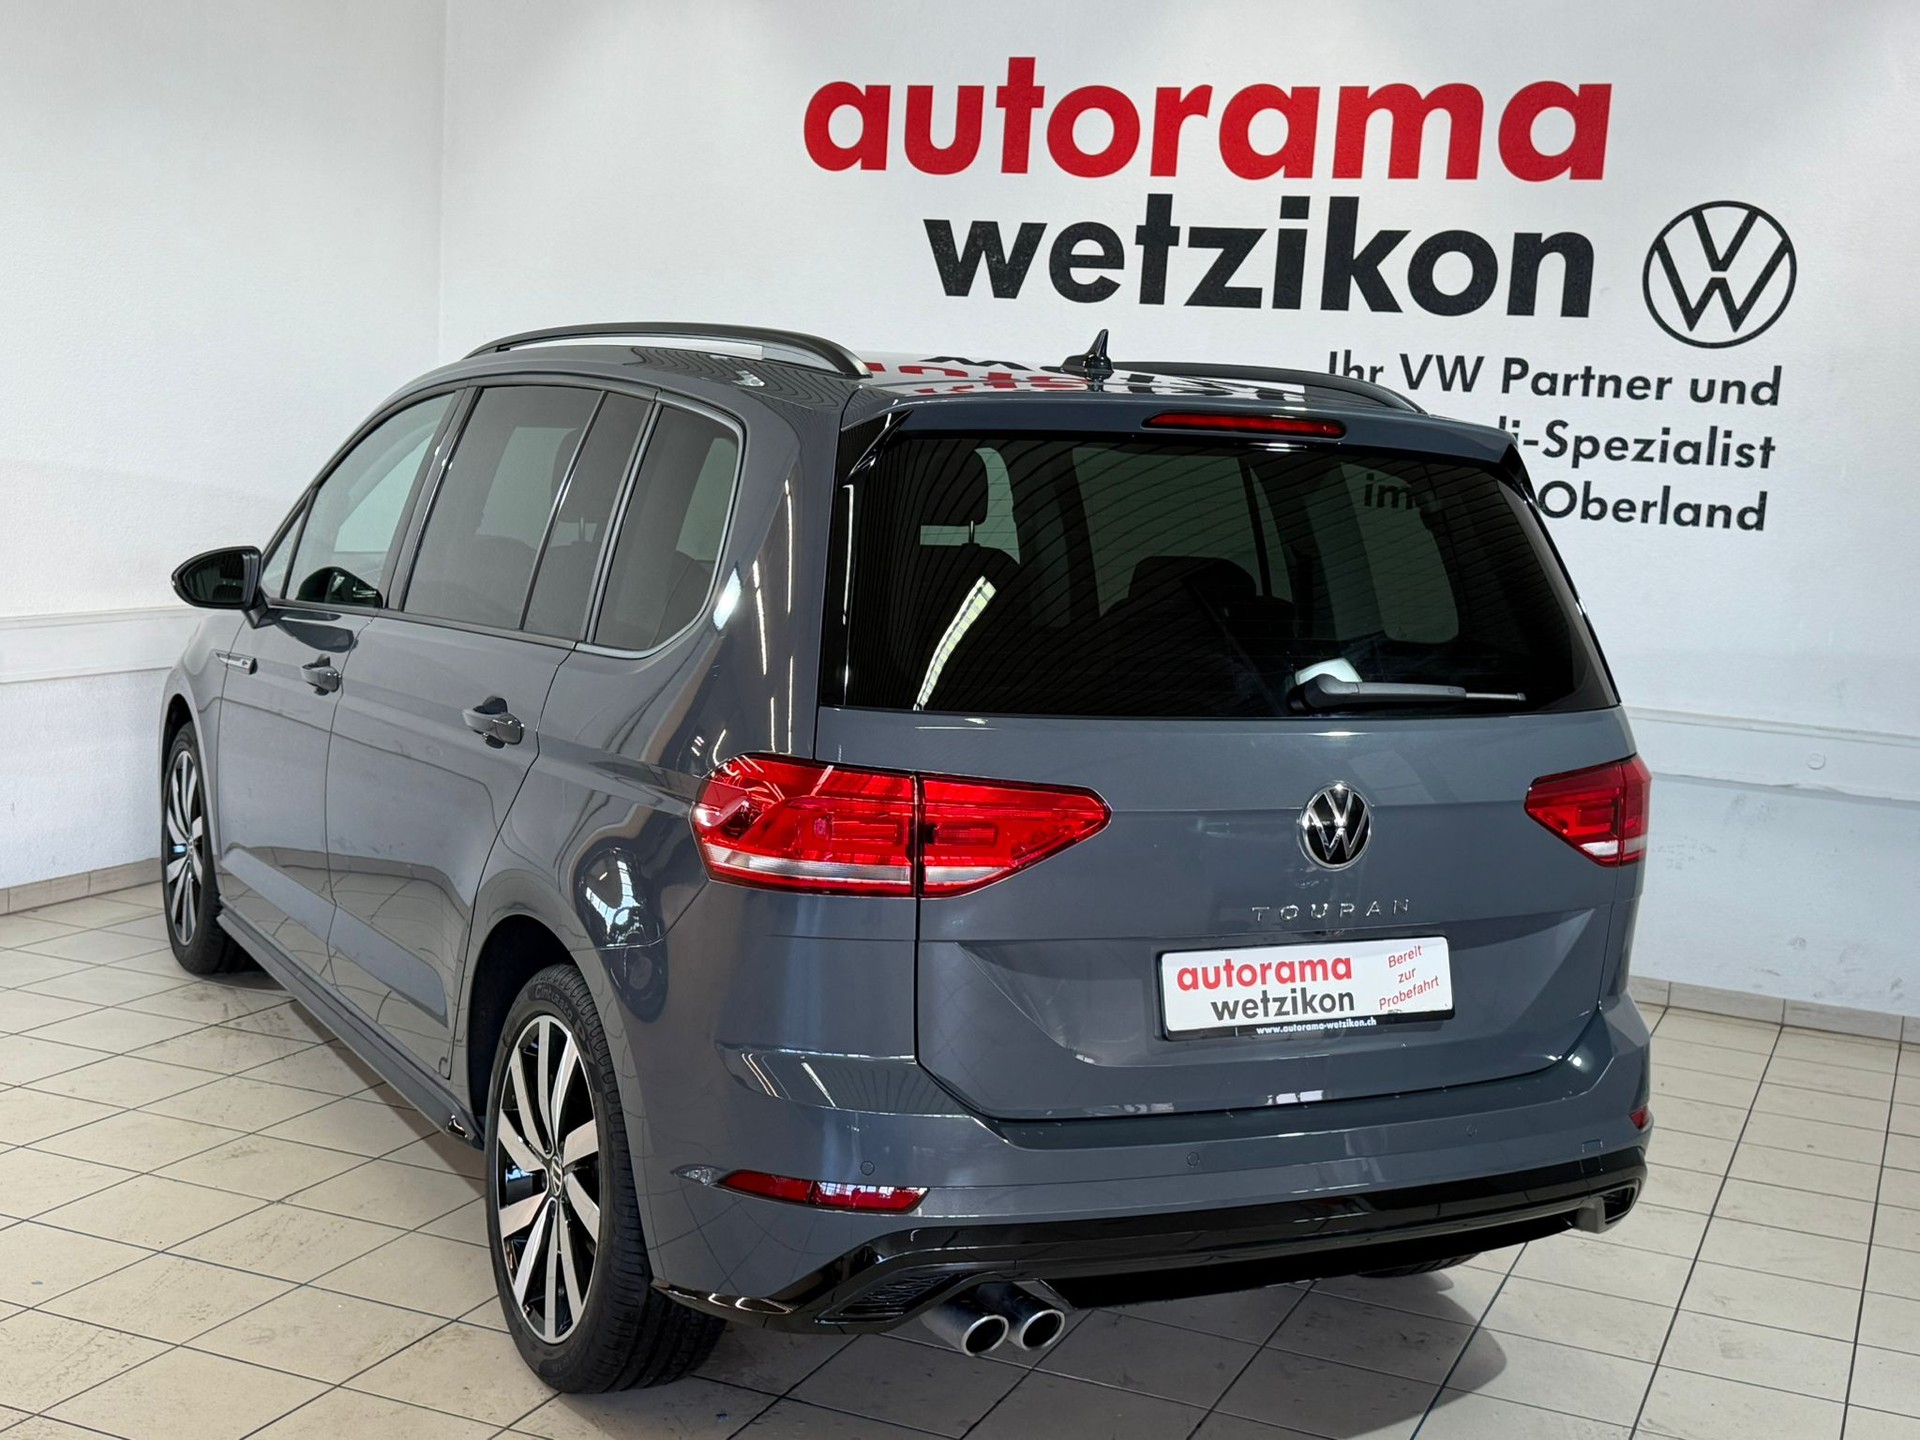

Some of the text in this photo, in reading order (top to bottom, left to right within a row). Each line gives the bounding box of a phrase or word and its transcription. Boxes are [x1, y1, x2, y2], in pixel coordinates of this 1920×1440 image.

[803, 57, 1612, 183] autorama
[923, 193, 1595, 317] wetzikon
[1328, 350, 1384, 384] Ihr
[1400, 353, 1485, 392] VW
[1501, 357, 1672, 401] Partner
[1689, 365, 1782, 406] und
[1499, 416, 1776, 469] i-Spezialist
[1538, 480, 1768, 531] Oberland
[1252, 899, 1409, 921] TOURAN
[1388, 945, 1422, 968] Bereit
[1177, 957, 1353, 992] autorama
[1398, 967, 1416, 984] zur
[1210, 987, 1355, 1021] wetzikon
[1379, 975, 1440, 1010] Probefahrt
[1256, 1016, 1377, 1035] www.autorama-wetzikon.ch
